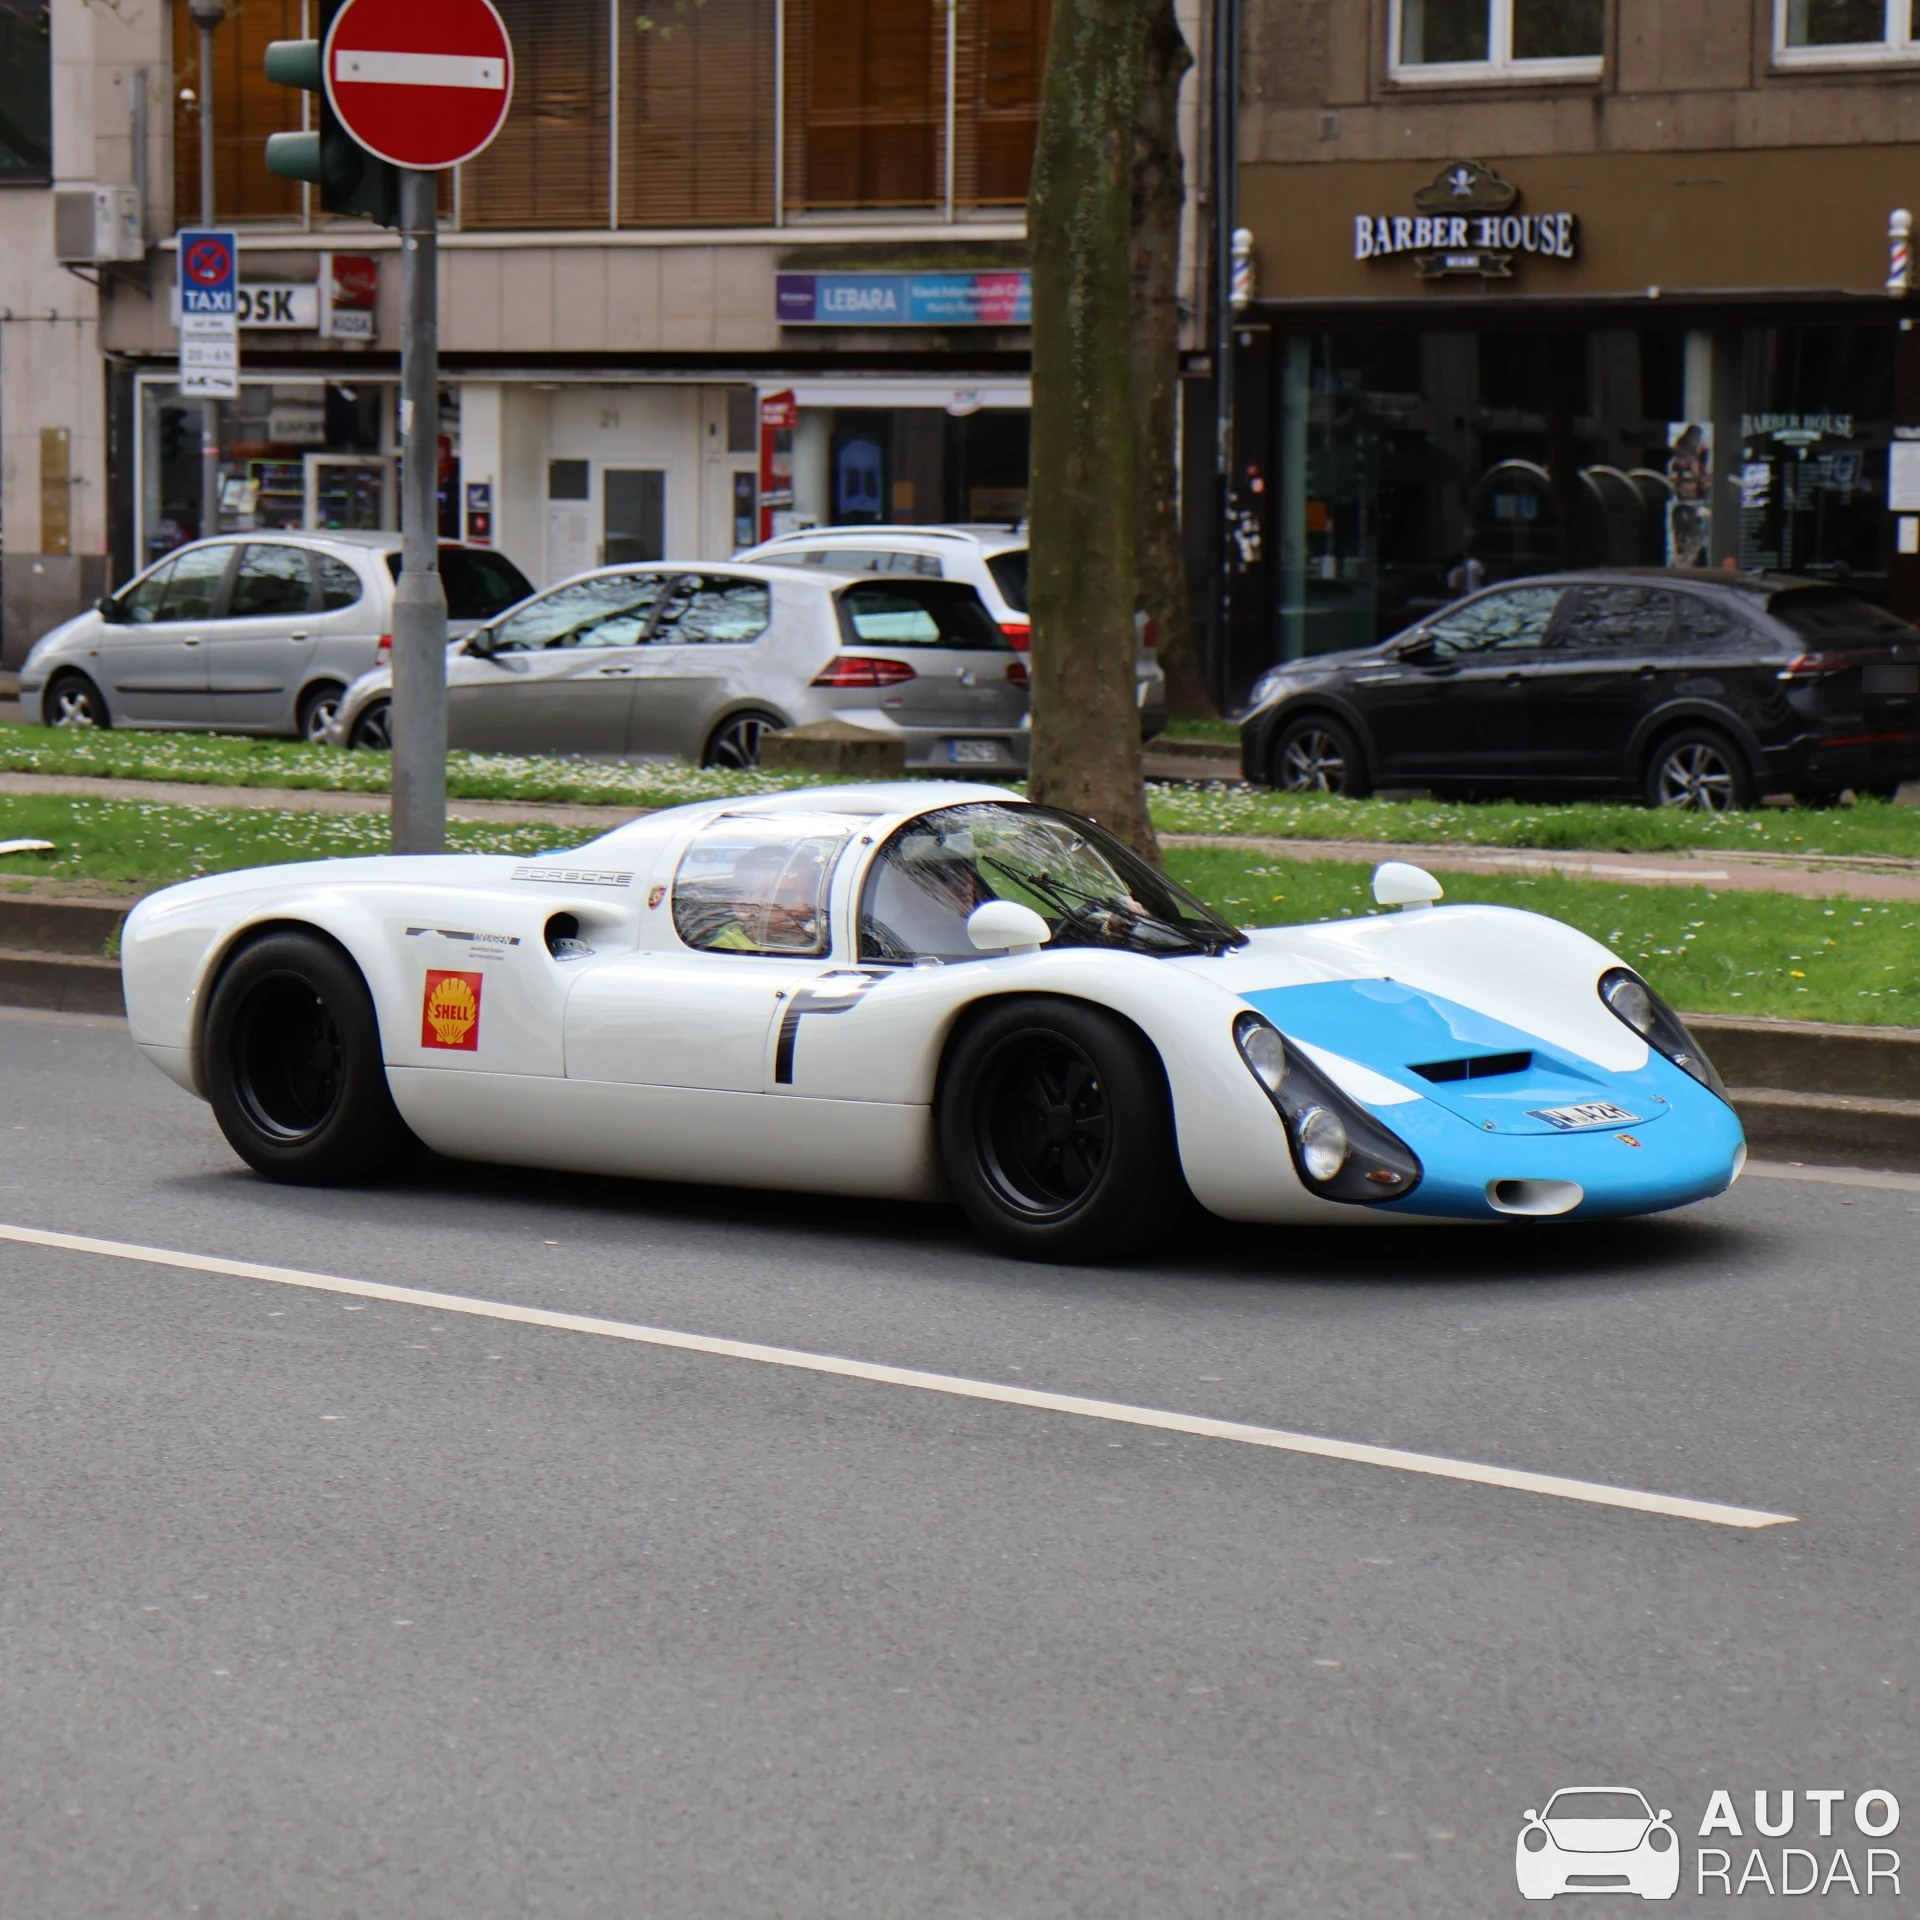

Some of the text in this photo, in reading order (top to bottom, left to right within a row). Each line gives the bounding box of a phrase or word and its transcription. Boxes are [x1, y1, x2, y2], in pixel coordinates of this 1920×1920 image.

[1354, 212, 1574, 260] BARBER HOUSE
[185, 290, 232, 311] TAXI
[823, 288, 897, 311] LEBARA
[512, 868, 634, 884] PORSCHE
[434, 1003, 469, 1022] SHELL
